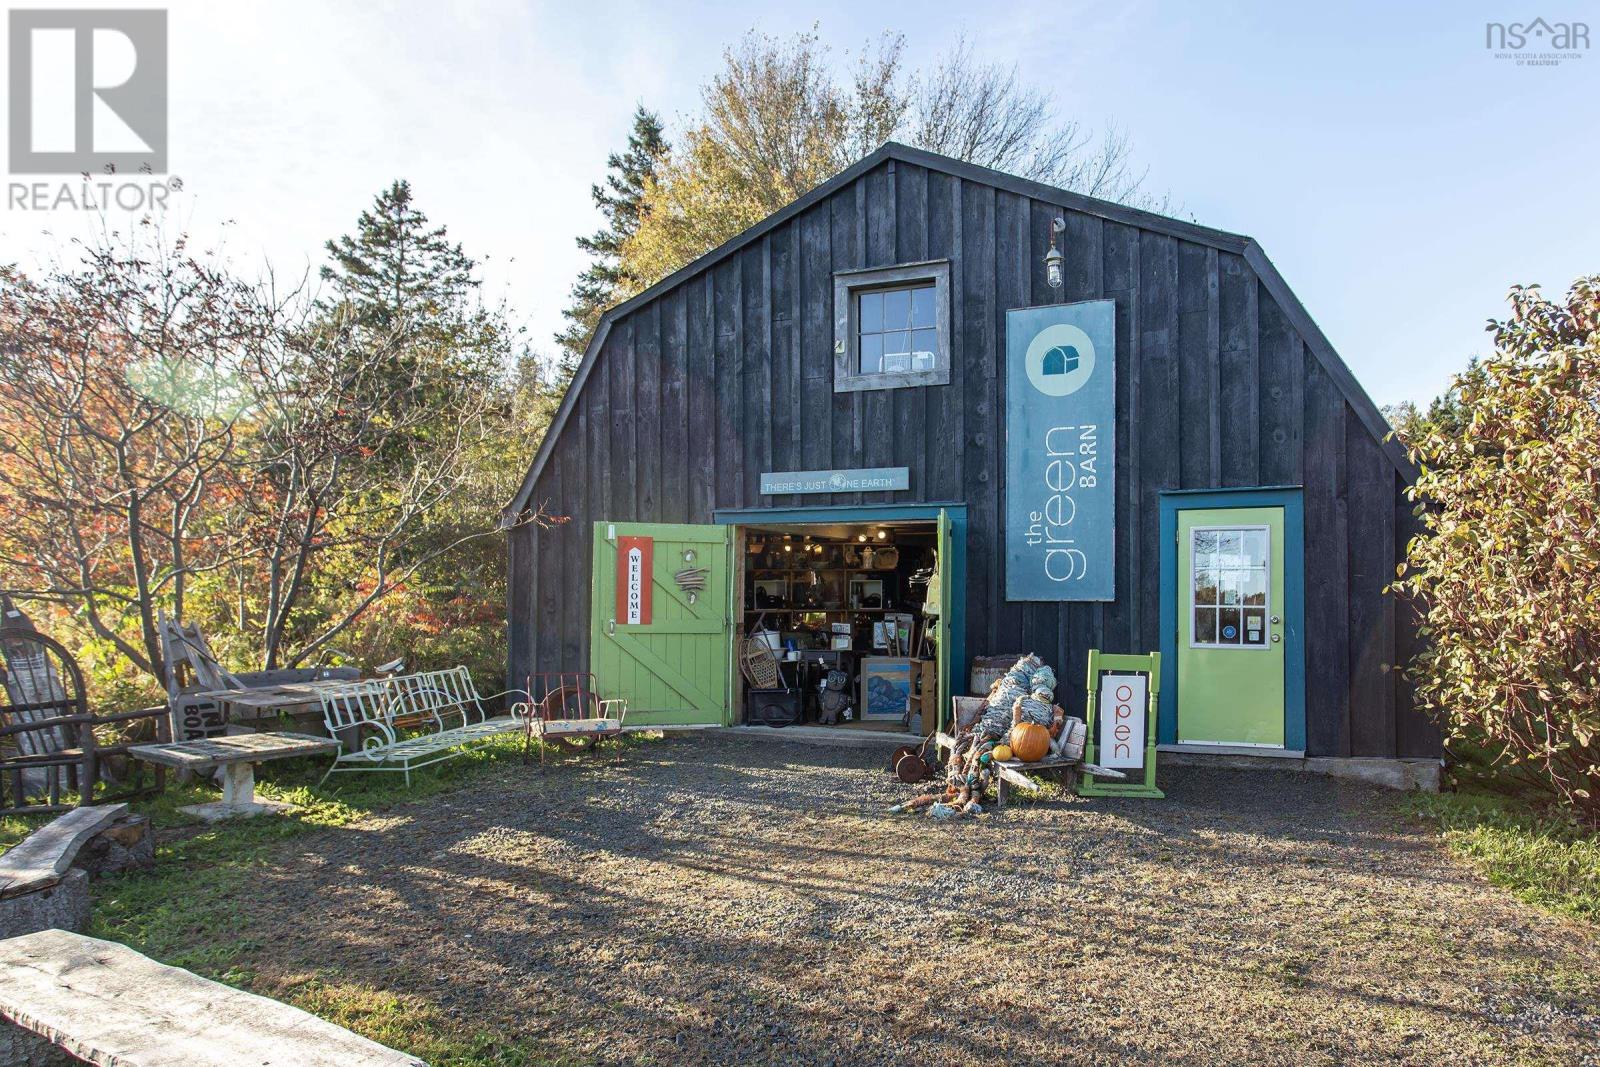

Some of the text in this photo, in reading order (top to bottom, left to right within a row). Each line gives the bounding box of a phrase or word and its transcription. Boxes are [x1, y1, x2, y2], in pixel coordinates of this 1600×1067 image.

[765, 482, 801, 492] THERE'S
[804, 480, 827, 490] JUST
[862, 478, 892, 488] EARTH
[1079, 424, 1097, 488] BARN
[1024, 511, 1042, 546] the
[1045, 426, 1087, 582] green
[630, 555, 640, 619] WELCOME
[1114, 685, 1132, 758] open
